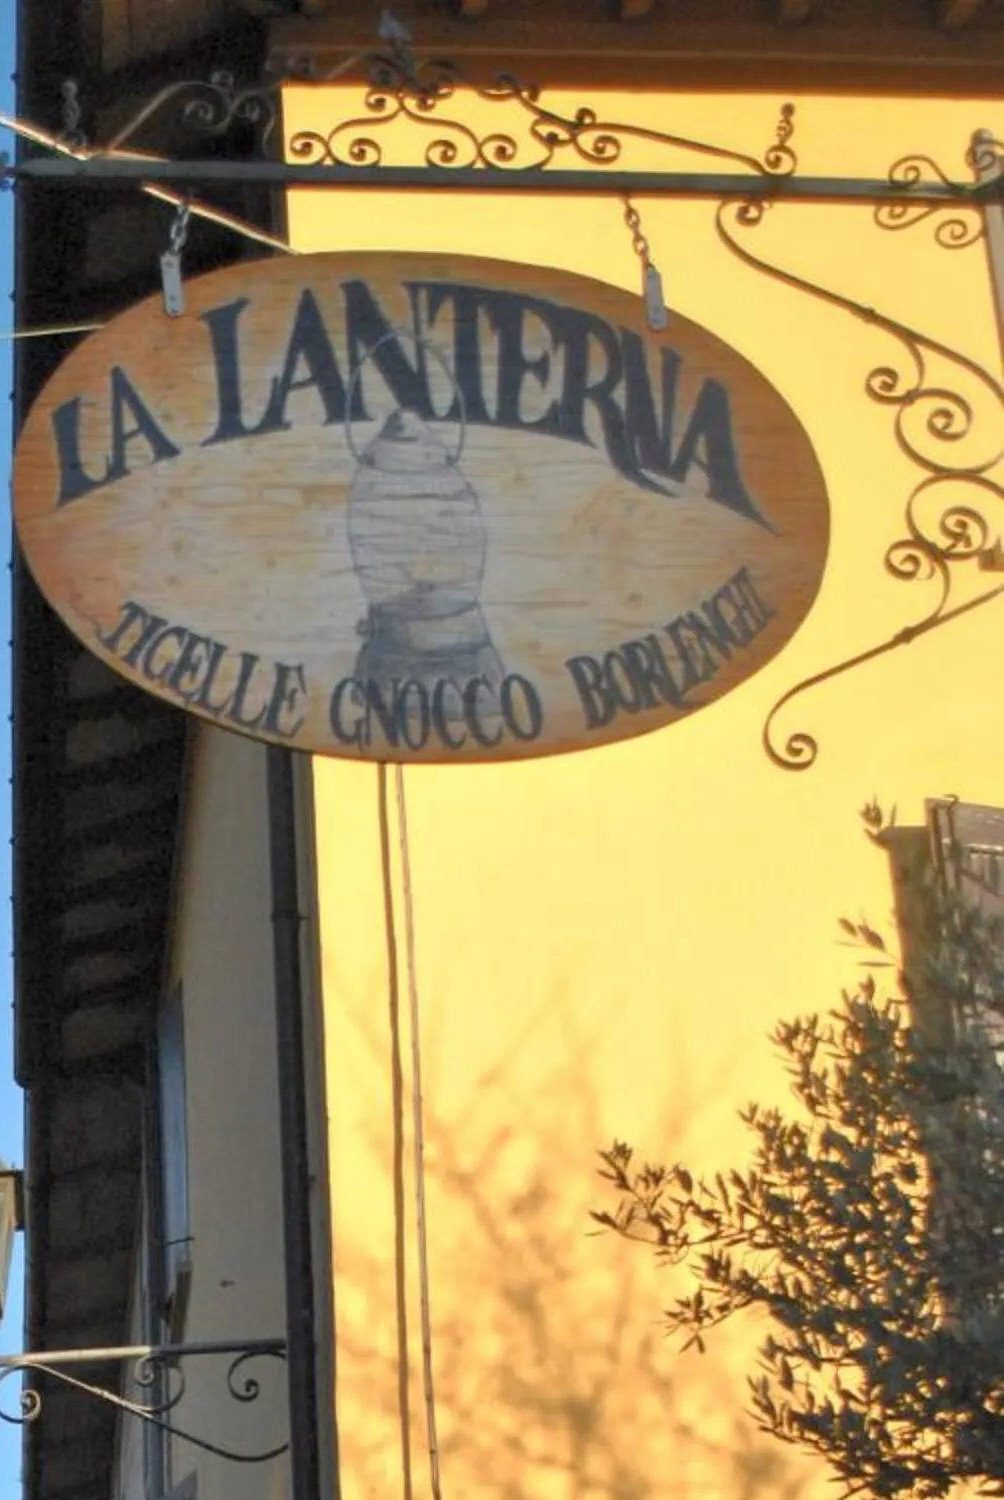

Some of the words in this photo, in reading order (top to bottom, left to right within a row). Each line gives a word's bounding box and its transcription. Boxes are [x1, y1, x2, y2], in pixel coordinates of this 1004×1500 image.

[51, 365, 182, 508] LA
[199, 279, 783, 537] LANTERNA
[329, 672, 544, 751] GNOCCO
[564, 565, 778, 731] BORLENGHI
